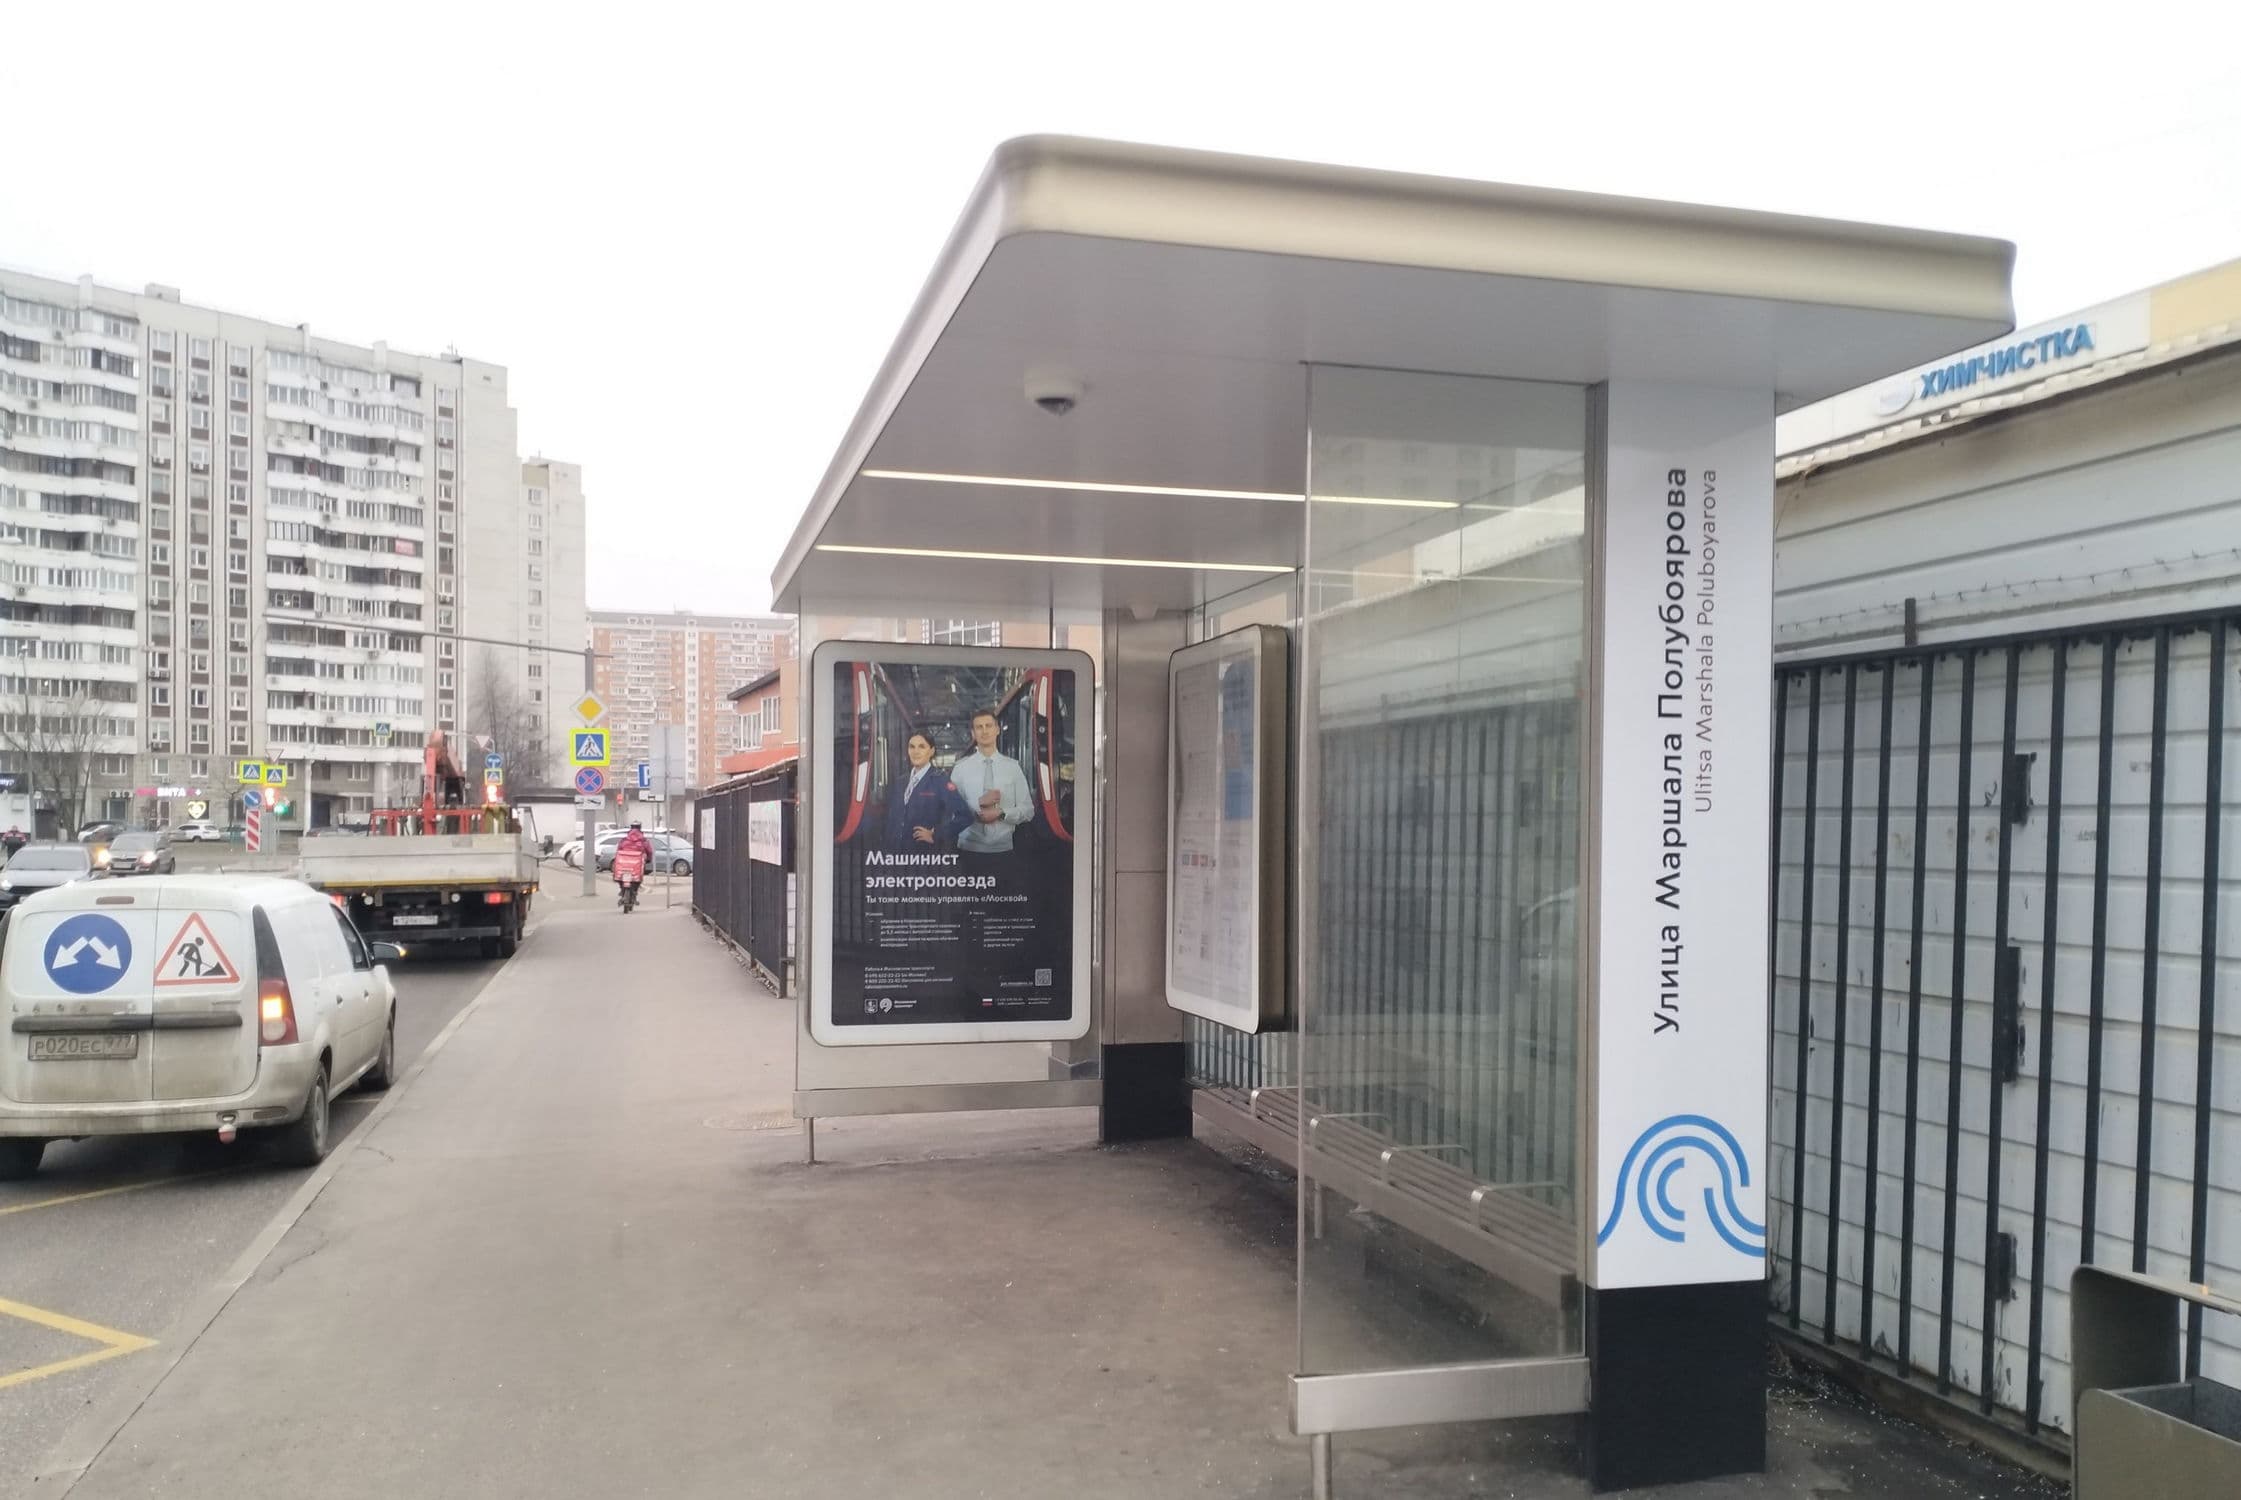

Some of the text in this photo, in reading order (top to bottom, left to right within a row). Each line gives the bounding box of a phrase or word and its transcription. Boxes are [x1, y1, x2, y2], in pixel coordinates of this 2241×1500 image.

[1920, 323, 2094, 400] ХИМЧИСТКА
[1694, 469, 1720, 813] Ulitsa Marshala Poluboyarova
[1653, 468, 1691, 1034] Улица Маршала Полубоярова
[865, 850, 959, 866] Машинист
[865, 875, 996, 891] электропоезда
[866, 894, 1028, 905] Ты тоже можешь управлять «Москвой»
